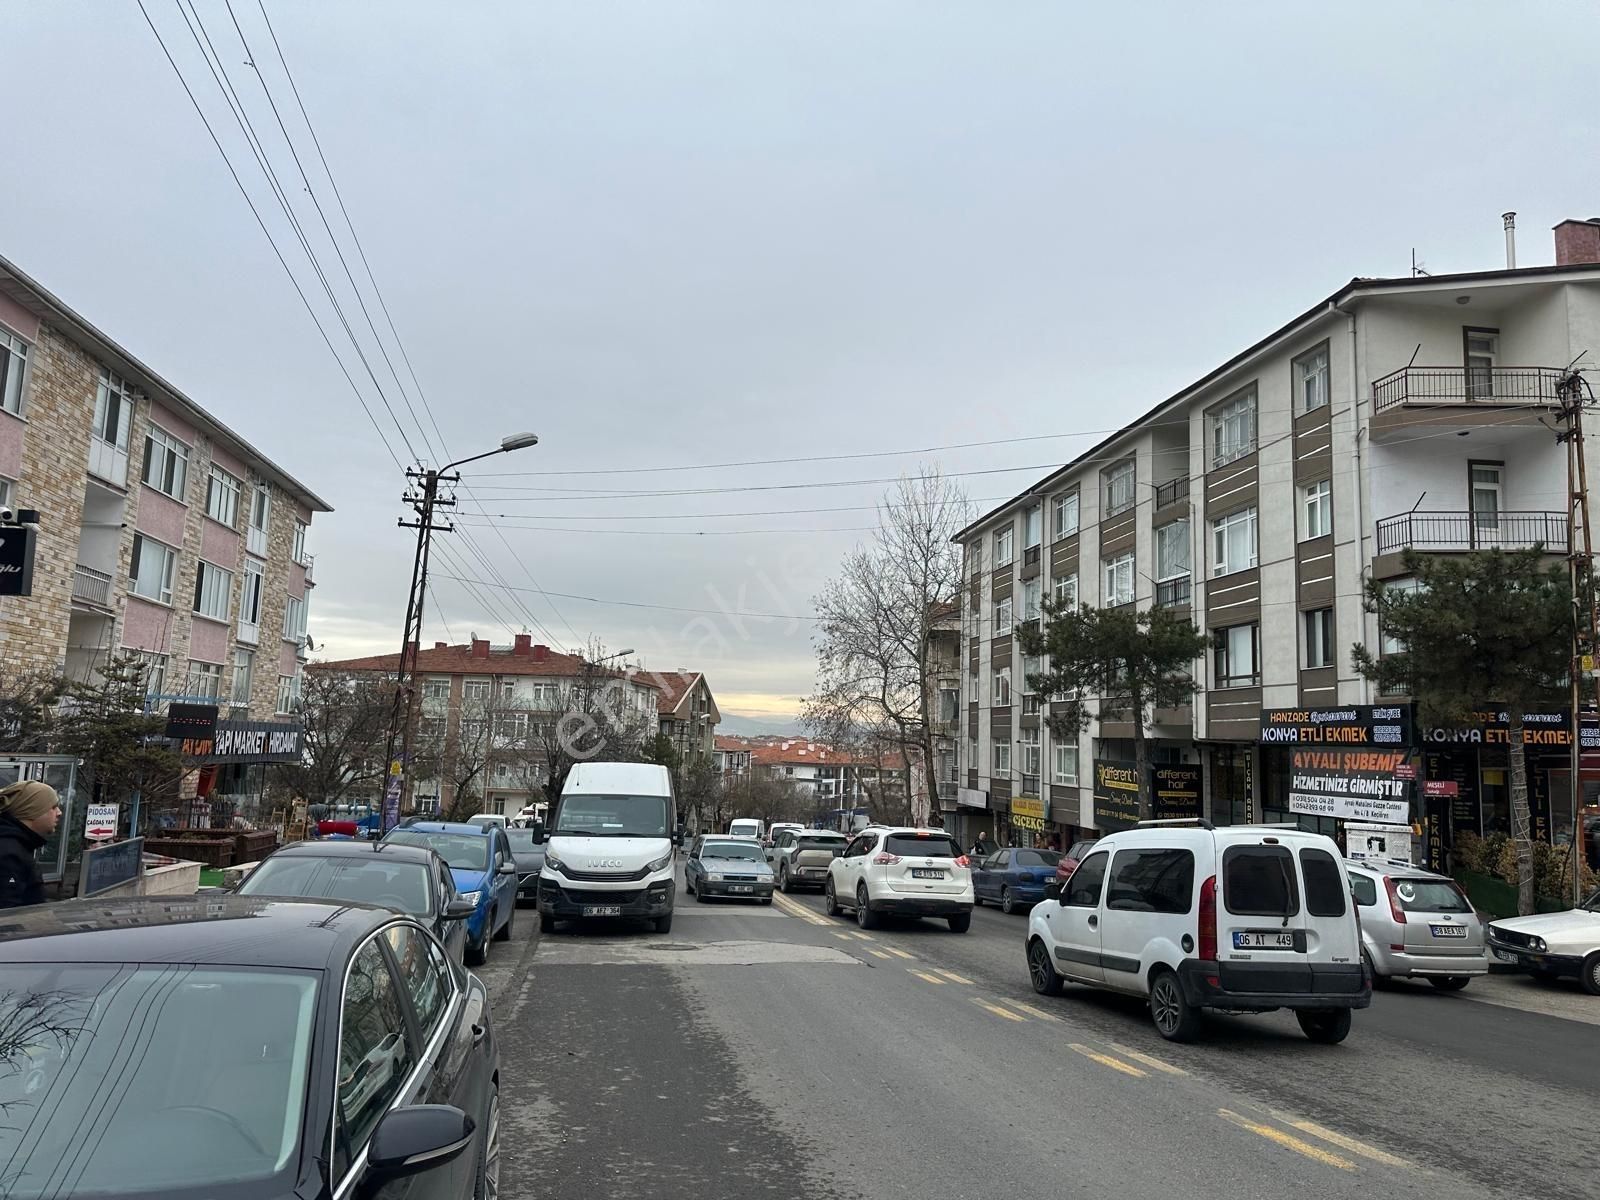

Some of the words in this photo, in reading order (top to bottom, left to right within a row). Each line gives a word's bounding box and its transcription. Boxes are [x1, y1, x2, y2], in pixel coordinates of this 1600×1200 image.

[1270, 712, 1309, 723] HANZADE
[1262, 727, 1298, 741] KONYA
[1300, 725, 1323, 742] ETLİ
[1326, 727, 1367, 742] EKMEK
[1422, 727, 1481, 743] KONYA
[1485, 729, 1510, 743] ETL
[216, 730, 232, 755] YAPI
[233, 731, 266, 754] MARKET
[269, 731, 298, 754] HIRDAVAT
[1294, 752, 1340, 769] AYVALI
[1344, 749, 1405, 774] ŞUBEMİZ
[1103, 766, 1132, 782] different
[1156, 769, 1198, 780] different
[1168, 780, 1186, 789] hair
[1293, 772, 1348, 792] HİZMETİNİZE
[1349, 775, 1402, 799] GİRMİŞTİR
[1431, 814, 1440, 870] EKMEK
[588, 859, 623, 868] IVECO
[1240, 935, 1250, 945] 06
[1255, 935, 1266, 945] AT
[1276, 936, 1291, 946] 449
